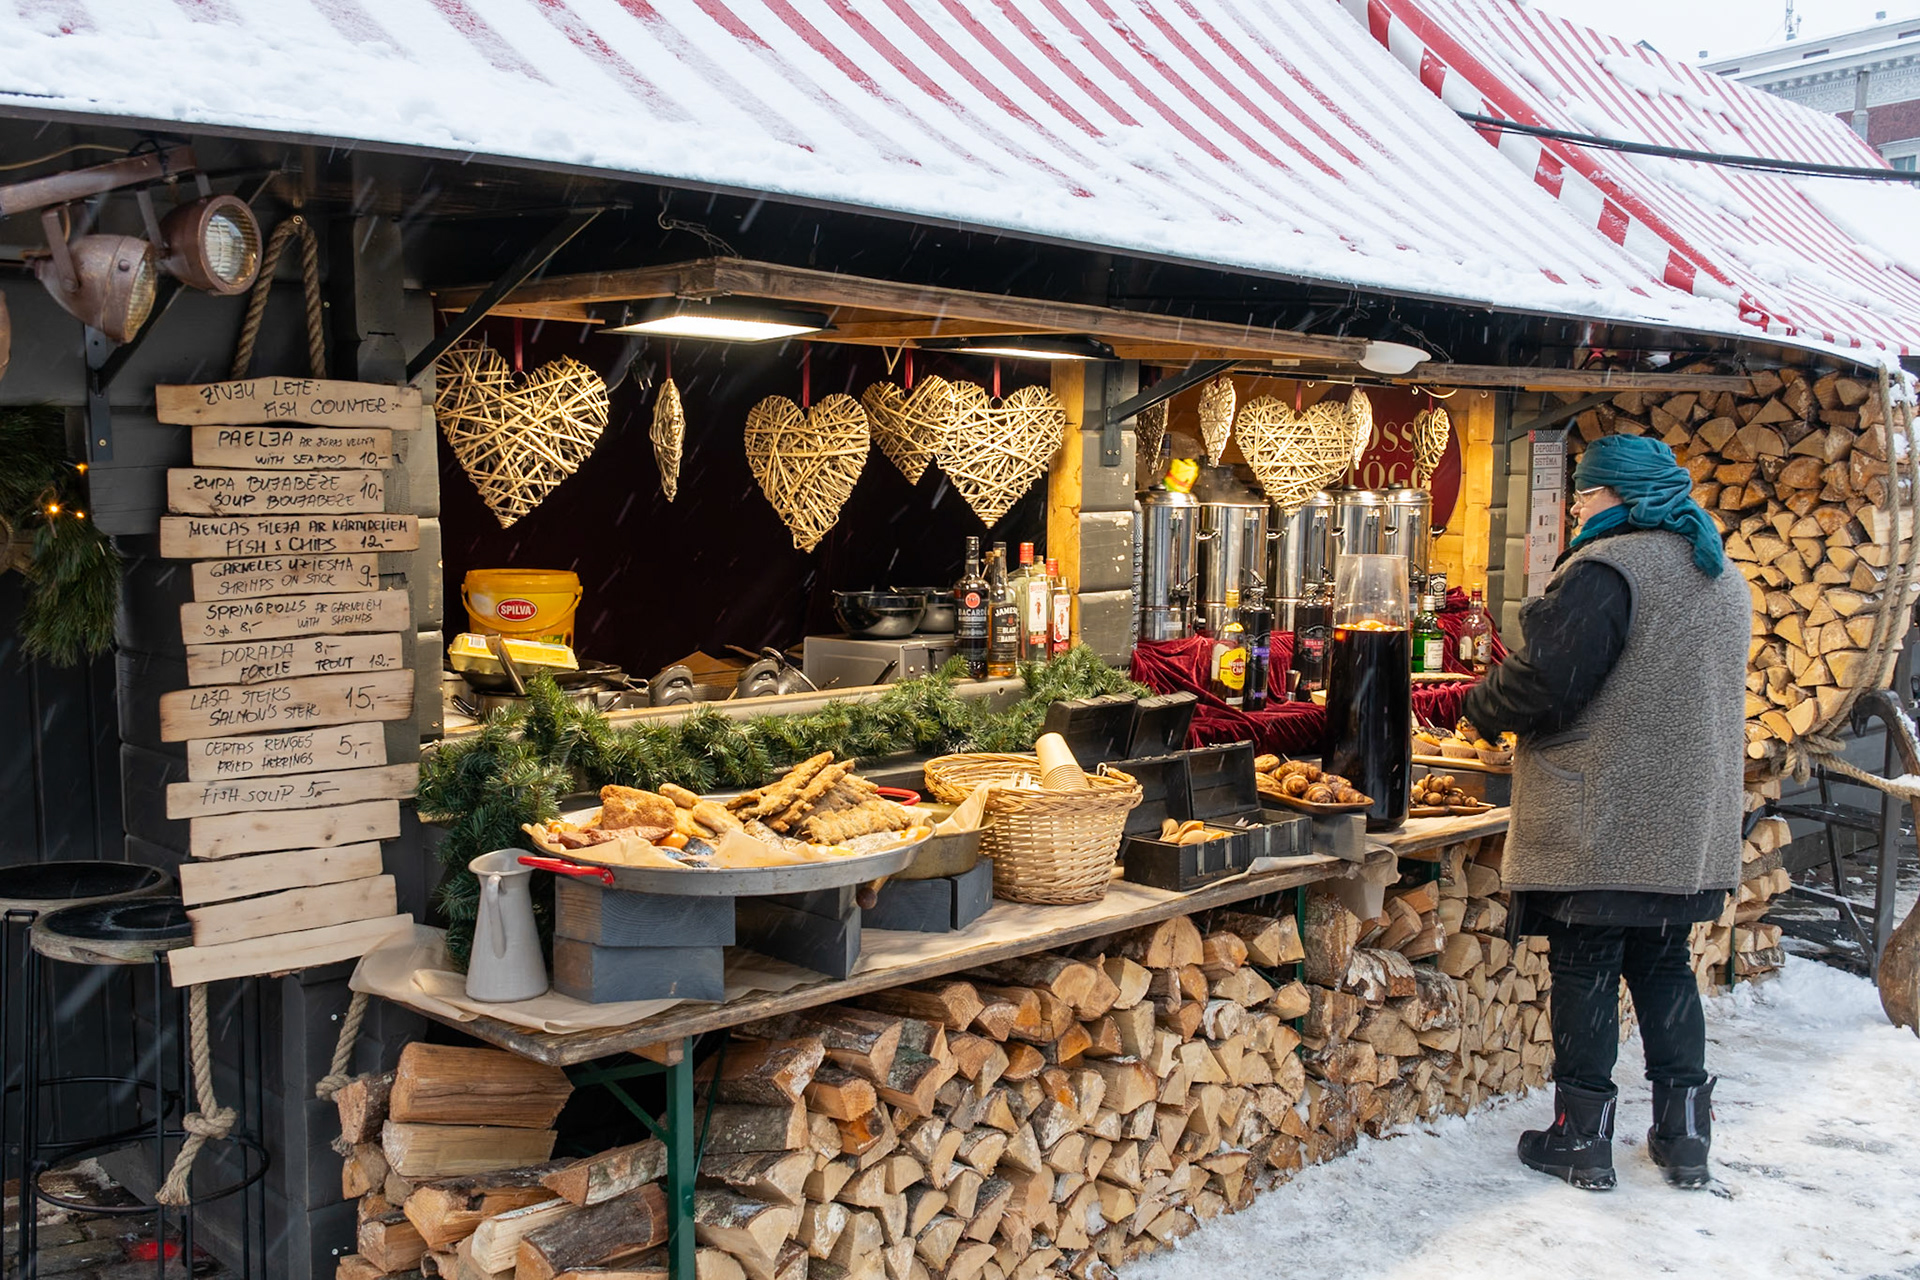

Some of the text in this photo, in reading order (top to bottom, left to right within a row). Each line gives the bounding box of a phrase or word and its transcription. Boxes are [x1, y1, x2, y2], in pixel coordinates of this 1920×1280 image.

[273, 379, 320, 396] LETE:
[264, 401, 297, 418] FISH
[299, 437, 312, 447] AR
[255, 454, 285, 465] WITH
[192, 475, 236, 491] ZUPA
[214, 491, 256, 507] SOUP
[189, 520, 250, 537] MENCAS
[258, 520, 300, 535] FILEJA
[309, 521, 327, 533] AR
[226, 539, 266, 556] FISH
[289, 537, 337, 552] CHIPS
[210, 559, 283, 578] GARNELES
[217, 572, 339, 596] SHRIMPS ON STICK
[206, 600, 307, 621] SPRINGROLLS
[315, 603, 328, 614] AR
[500, 605, 532, 615] SPILVA
[203, 624, 215, 638] 3
[297, 616, 320, 630] WITH
[331, 612, 373, 627] SHRIMPS
[221, 642, 295, 667] DORADA
[240, 661, 291, 682] FORELE
[315, 656, 355, 671] TROUT
[190, 689, 232, 711] LAŠA
[241, 686, 291, 705] STEIKS
[205, 740, 254, 756] CEPTAS
[217, 752, 314, 775] FRIED HERRINGS
[199, 786, 240, 806] FISH
[241, 784, 294, 803] SOUP
